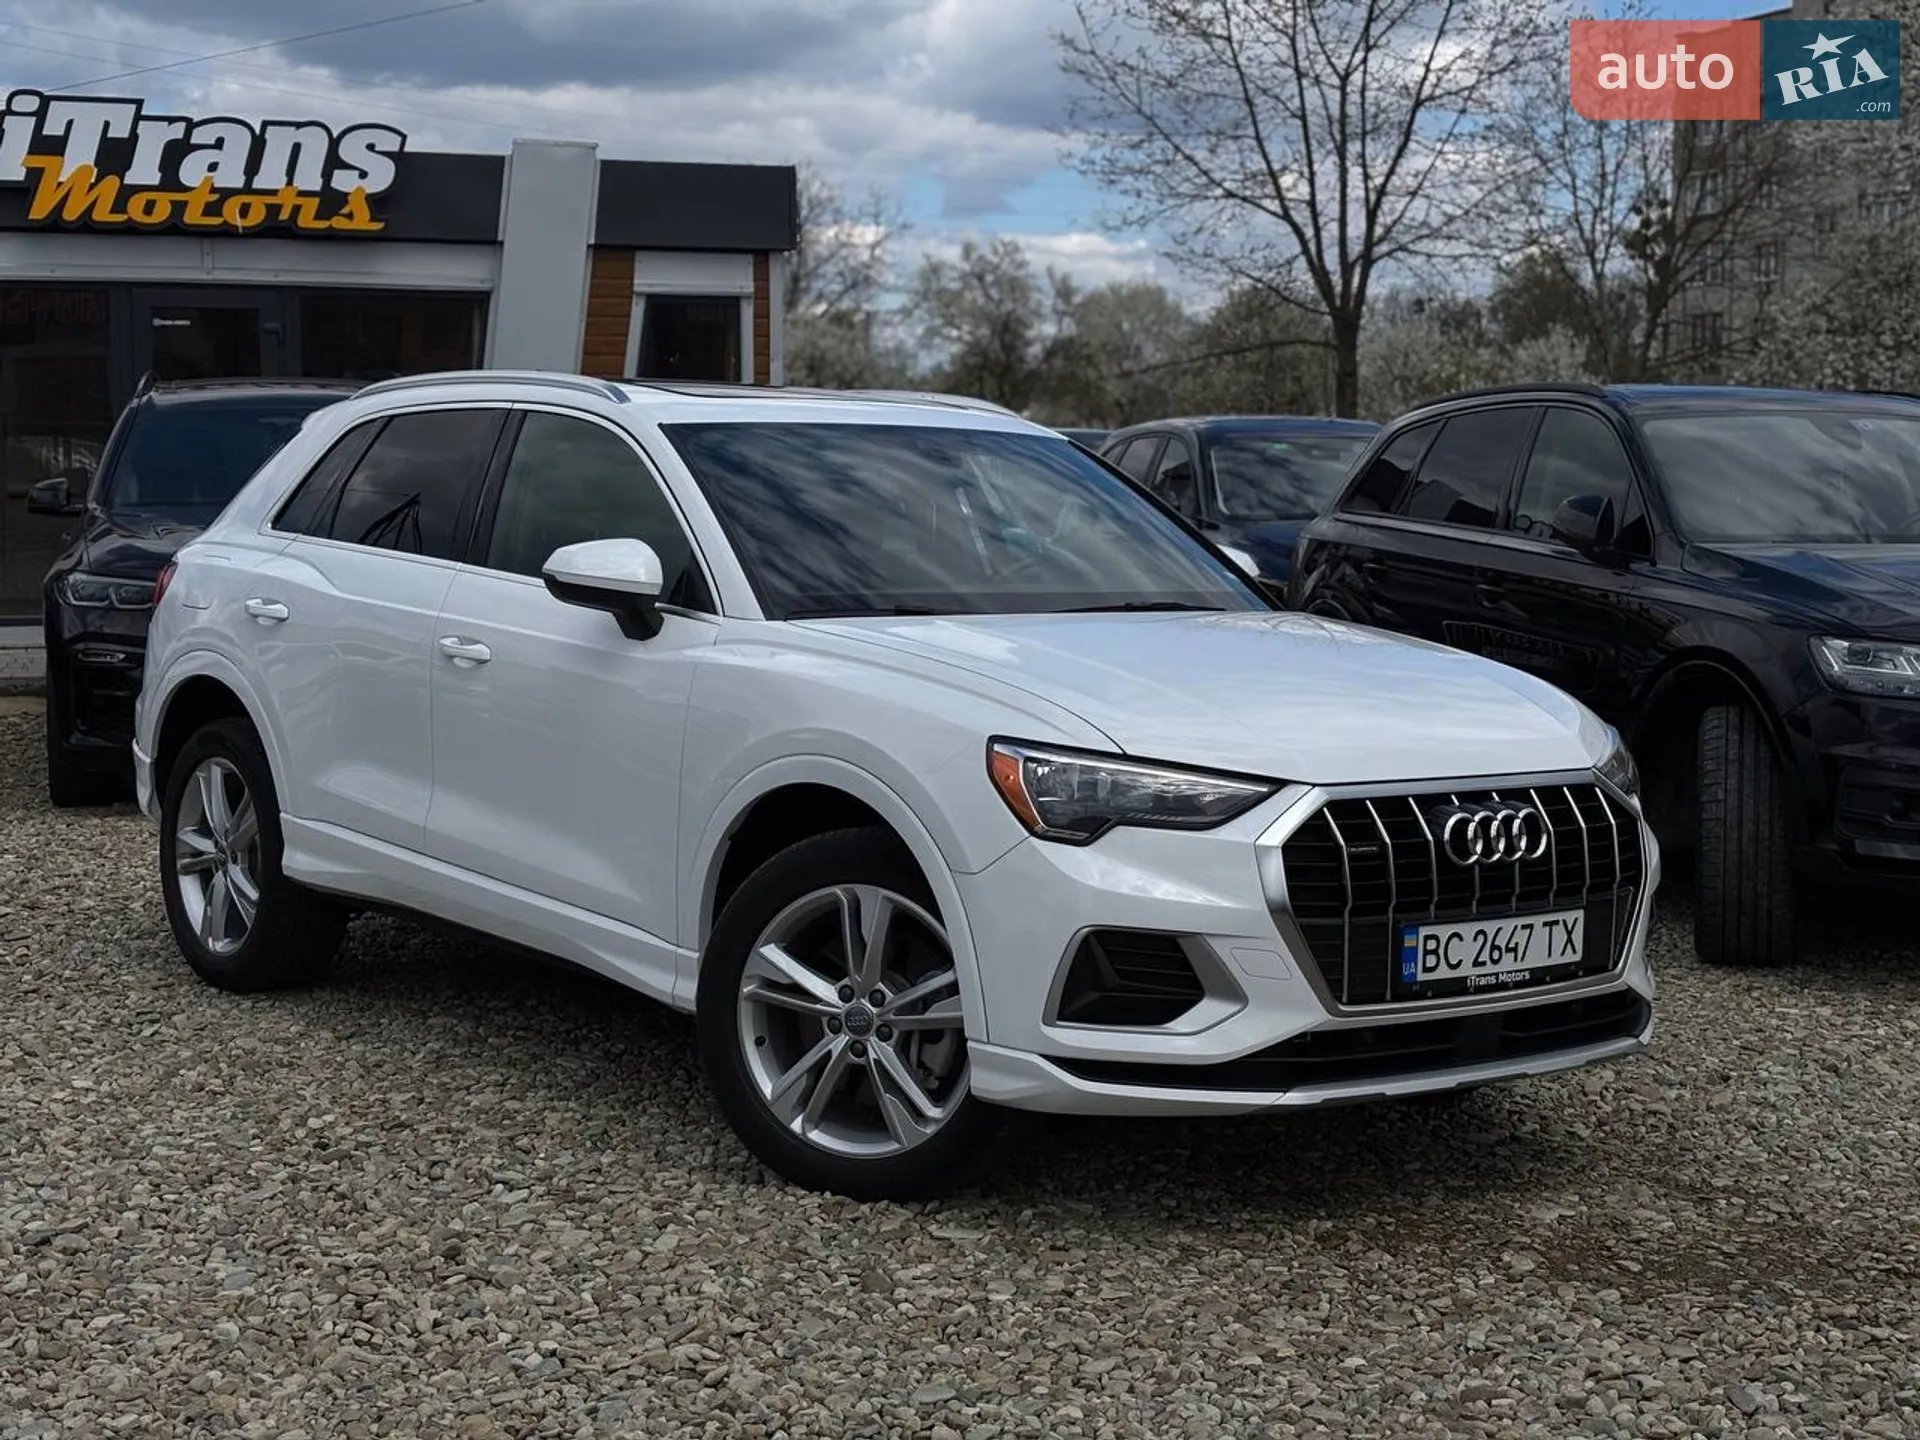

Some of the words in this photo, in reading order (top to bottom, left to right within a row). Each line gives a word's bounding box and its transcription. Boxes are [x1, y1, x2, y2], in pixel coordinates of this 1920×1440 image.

[0, 90, 402, 194] iTrans
[23, 154, 386, 231] Motors
[1402, 961, 1416, 975] UA
[1422, 931, 1463, 973] BC
[1472, 923, 1535, 968] 2647
[1542, 917, 1579, 958] TX
[1467, 973, 1497, 987] iTrans
[1499, 970, 1531, 984] Motors
